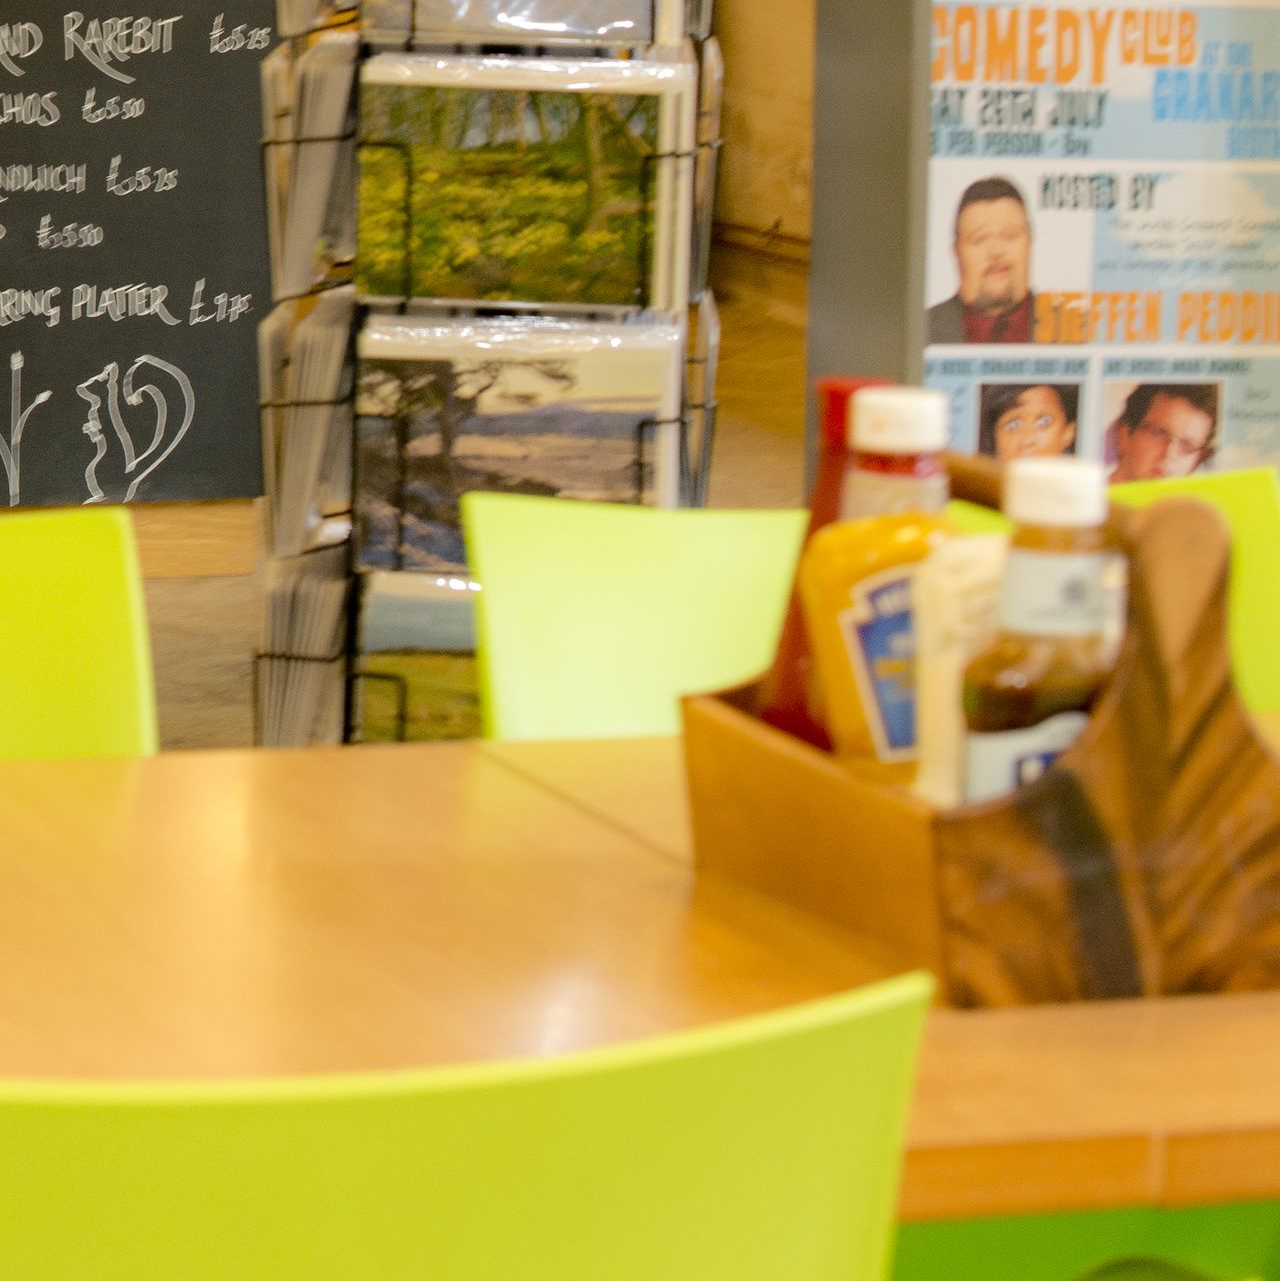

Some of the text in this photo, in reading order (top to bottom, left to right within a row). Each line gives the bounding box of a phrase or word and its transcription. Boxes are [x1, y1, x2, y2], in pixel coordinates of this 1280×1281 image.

[62, 10, 184, 84] RAREBIT
[930, 5, 1198, 85] COMEDY CLUB
[1048, 89, 1108, 129] JULY
[1040, 172, 1161, 211] HOSTED BY
